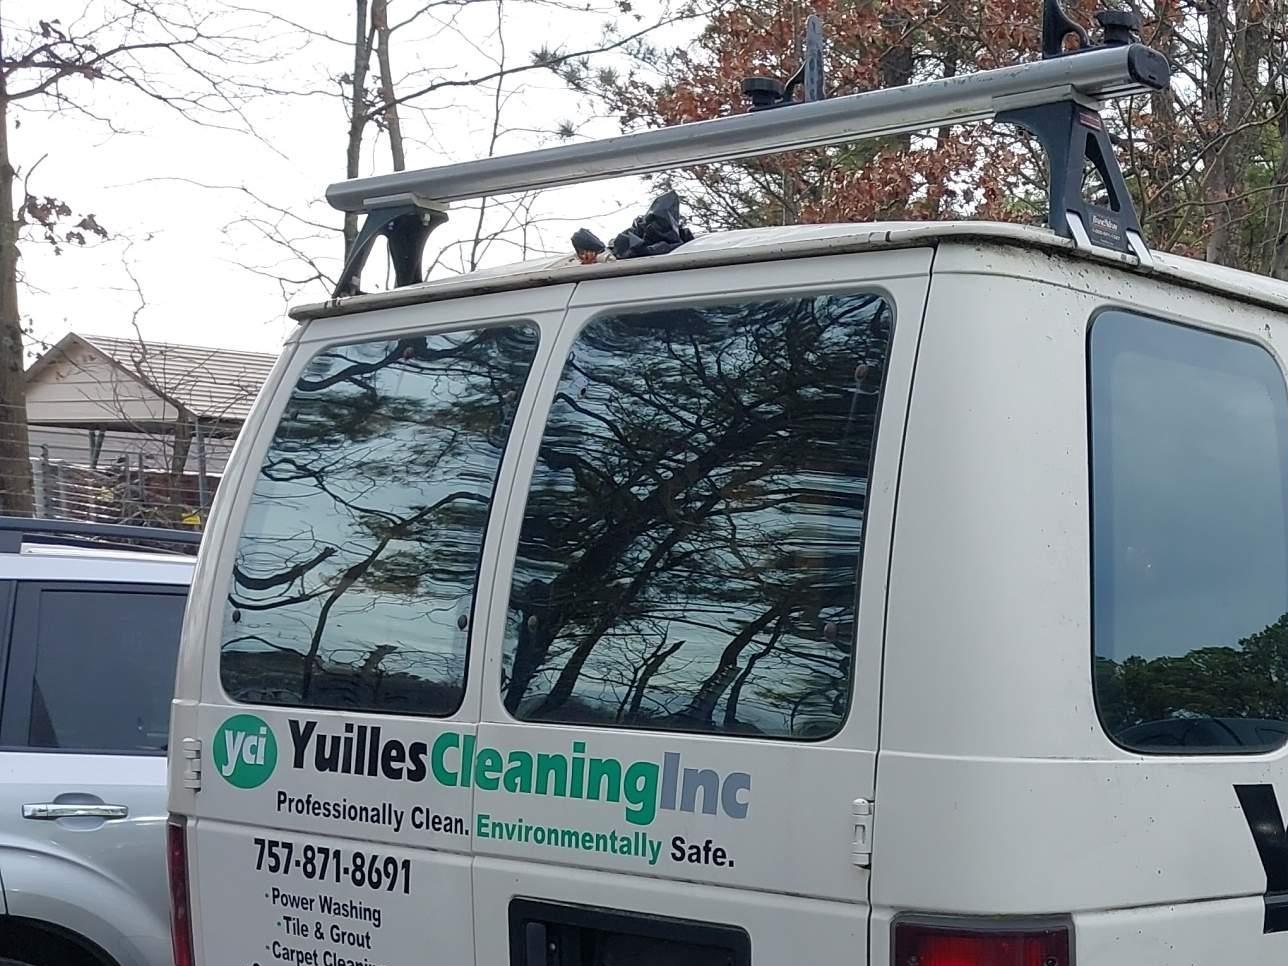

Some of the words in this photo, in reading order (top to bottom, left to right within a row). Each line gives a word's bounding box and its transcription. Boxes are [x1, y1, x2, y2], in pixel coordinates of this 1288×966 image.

[222, 726, 266, 776] yci
[277, 791, 404, 832] Professionally
[411, 807, 469, 835] Clean.
[477, 814, 661, 865] Environmentally
[671, 836, 734, 867] Safe.
[254, 838, 411, 894] 757-871-8691
[272, 887, 314, 912] Power
[319, 895, 381, 927] Washing
[283, 916, 309, 937] Tile
[315, 923, 324, 940] &
[330, 925, 371, 949] Grout
